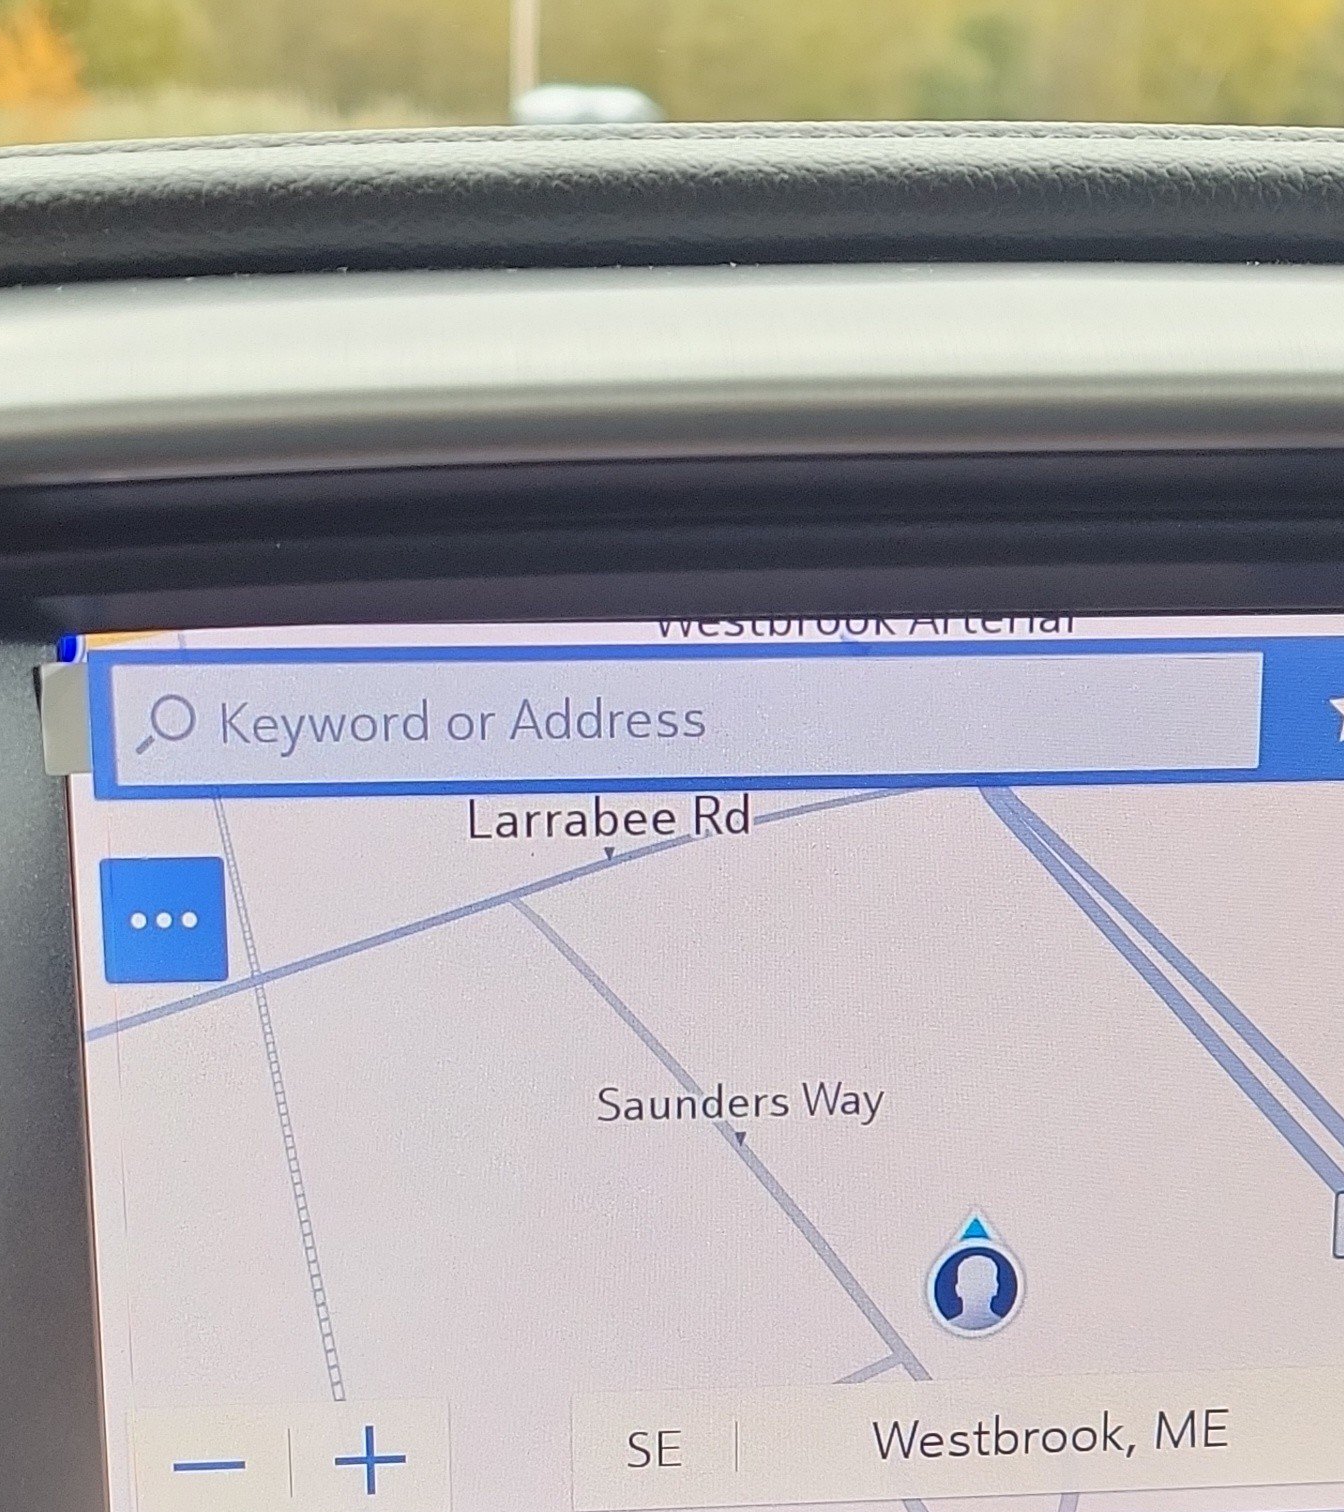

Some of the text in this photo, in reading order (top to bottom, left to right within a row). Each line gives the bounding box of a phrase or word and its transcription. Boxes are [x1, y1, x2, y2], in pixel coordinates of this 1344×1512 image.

[220, 696, 706, 757] Keyword or Address
[469, 793, 750, 839] Larrabee Rd
[598, 1081, 885, 1125] Saunders Way
[627, 1430, 682, 1467] SE
[872, 1409, 1229, 1460] Westbrook, ME
